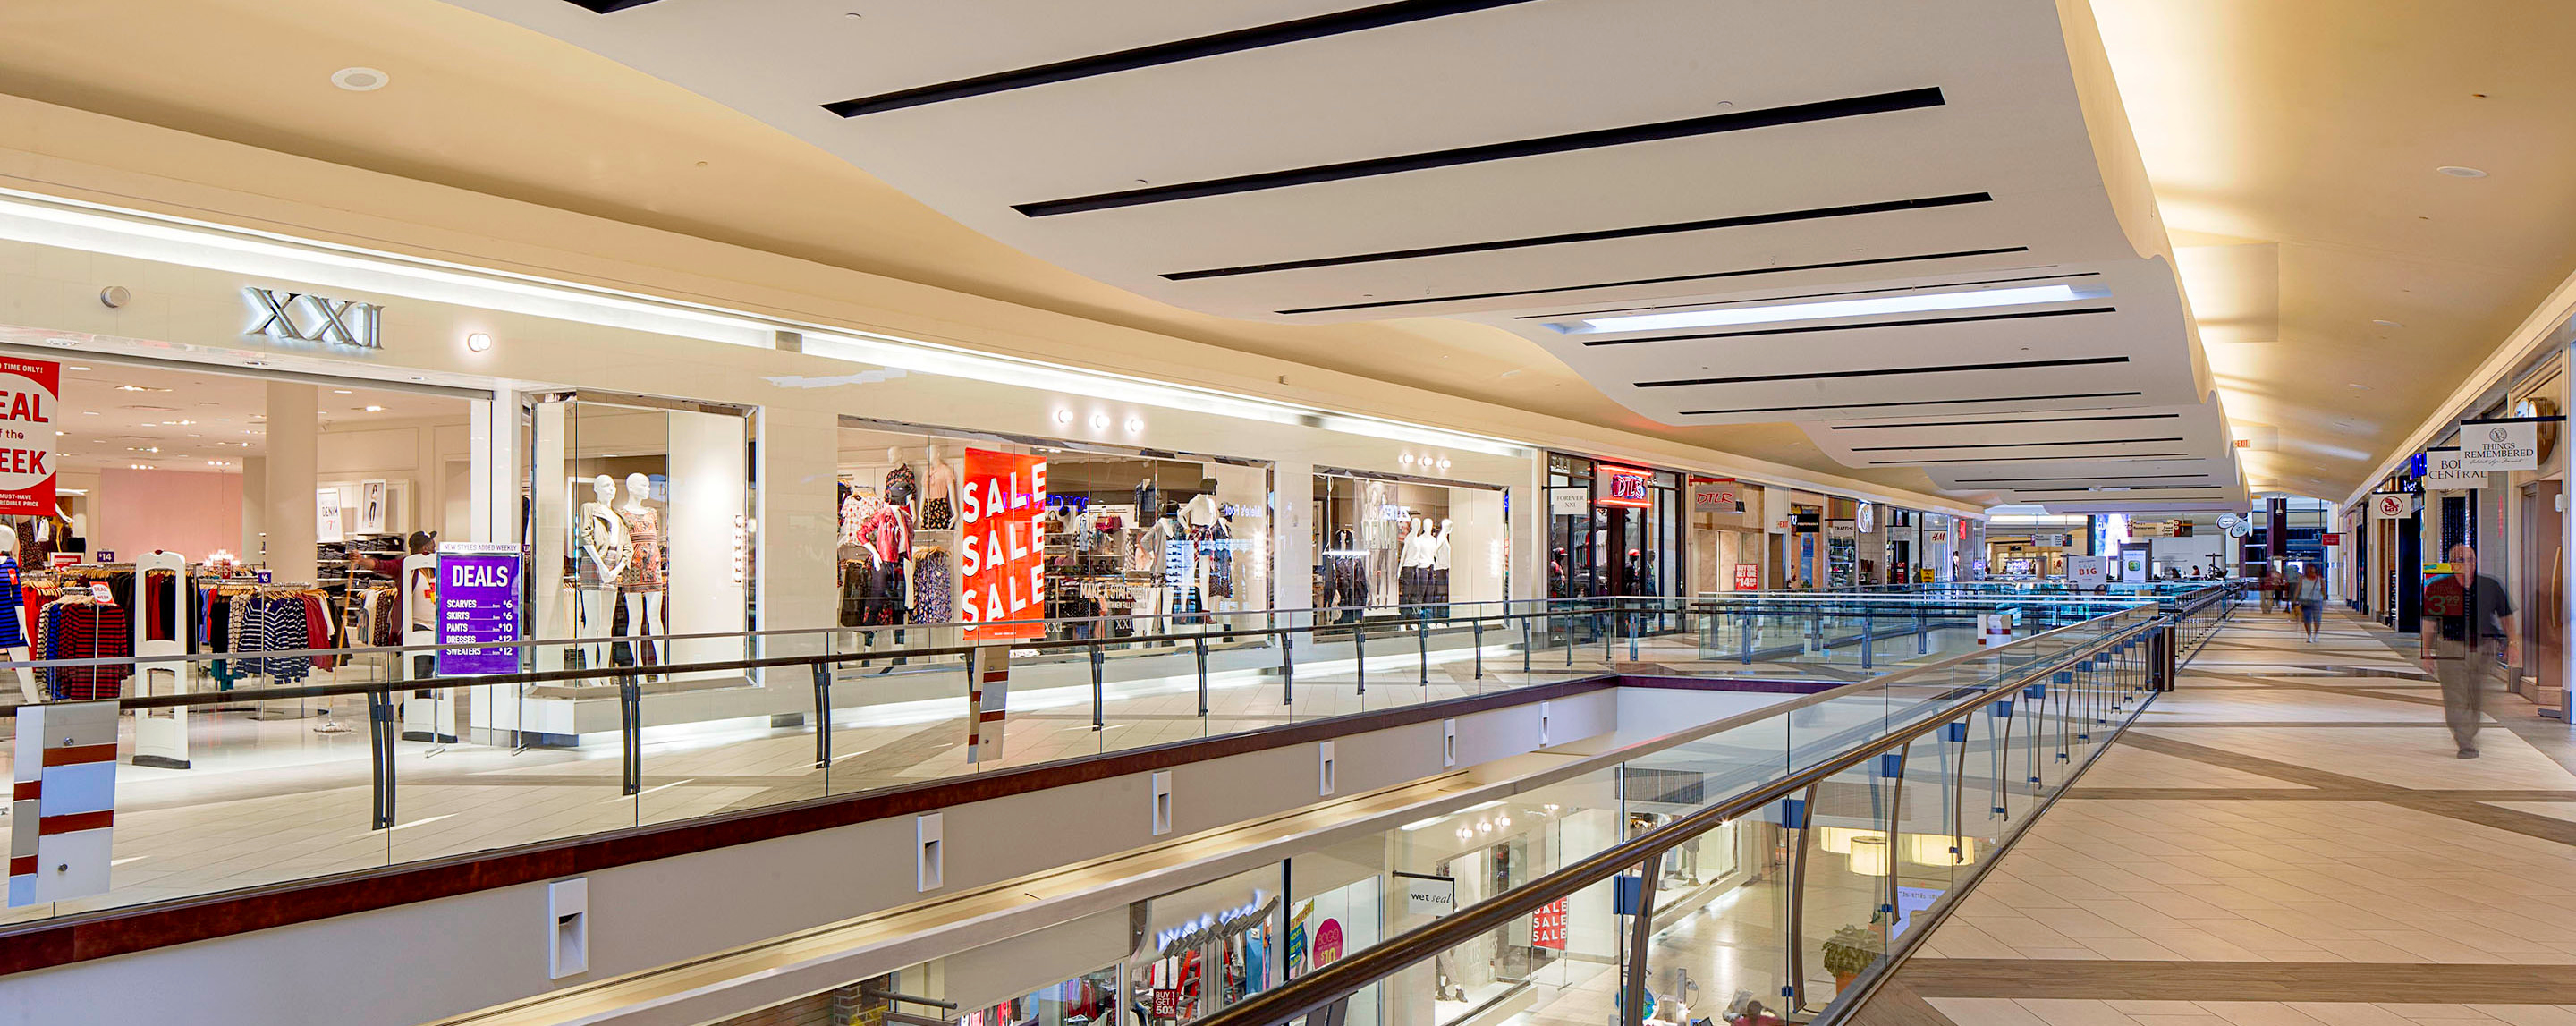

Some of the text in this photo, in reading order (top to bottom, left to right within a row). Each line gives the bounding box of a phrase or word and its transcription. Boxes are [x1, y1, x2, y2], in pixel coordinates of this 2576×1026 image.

[242, 286, 386, 350] XXI
[4, 363, 43, 374] TIME ONLY!
[6, 429, 24, 440] the
[2464, 449, 2534, 459] REMEMBERED
[2441, 460, 2461, 469] BO
[2428, 471, 2487, 479] CENTRAL
[962, 462, 1046, 523] SALE
[1615, 476, 1644, 499] DTLR
[1696, 492, 1733, 504] DTLR
[962, 512, 1046, 577] SALE
[452, 565, 509, 587] DEALS
[2079, 567, 2097, 575] BIG
[1080, 582, 1103, 598] MAKE
[1104, 583, 1109, 598] A
[446, 599, 478, 608] SCARVES
[503, 599, 513, 608] $6
[962, 564, 1045, 632] SALE
[446, 611, 470, 620] SKIRTS
[503, 611, 513, 620] $6
[446, 623, 469, 632] PANTS
[498, 623, 513, 632] $10
[1045, 622, 1063, 633] XXI
[1116, 618, 1132, 630] XXI
[446, 635, 477, 643] DRESSES
[498, 635, 513, 643] $12
[446, 648, 481, 656] SWEATERS
[499, 647, 513, 656] $12
[1411, 893, 1452, 903] wet seal
[1533, 915, 1567, 928] SALE
[1318, 928, 1339, 946] BOGO
[1532, 928, 1567, 942] SALE
[1320, 947, 1336, 964] $10
[1156, 991, 1170, 999] BUY
